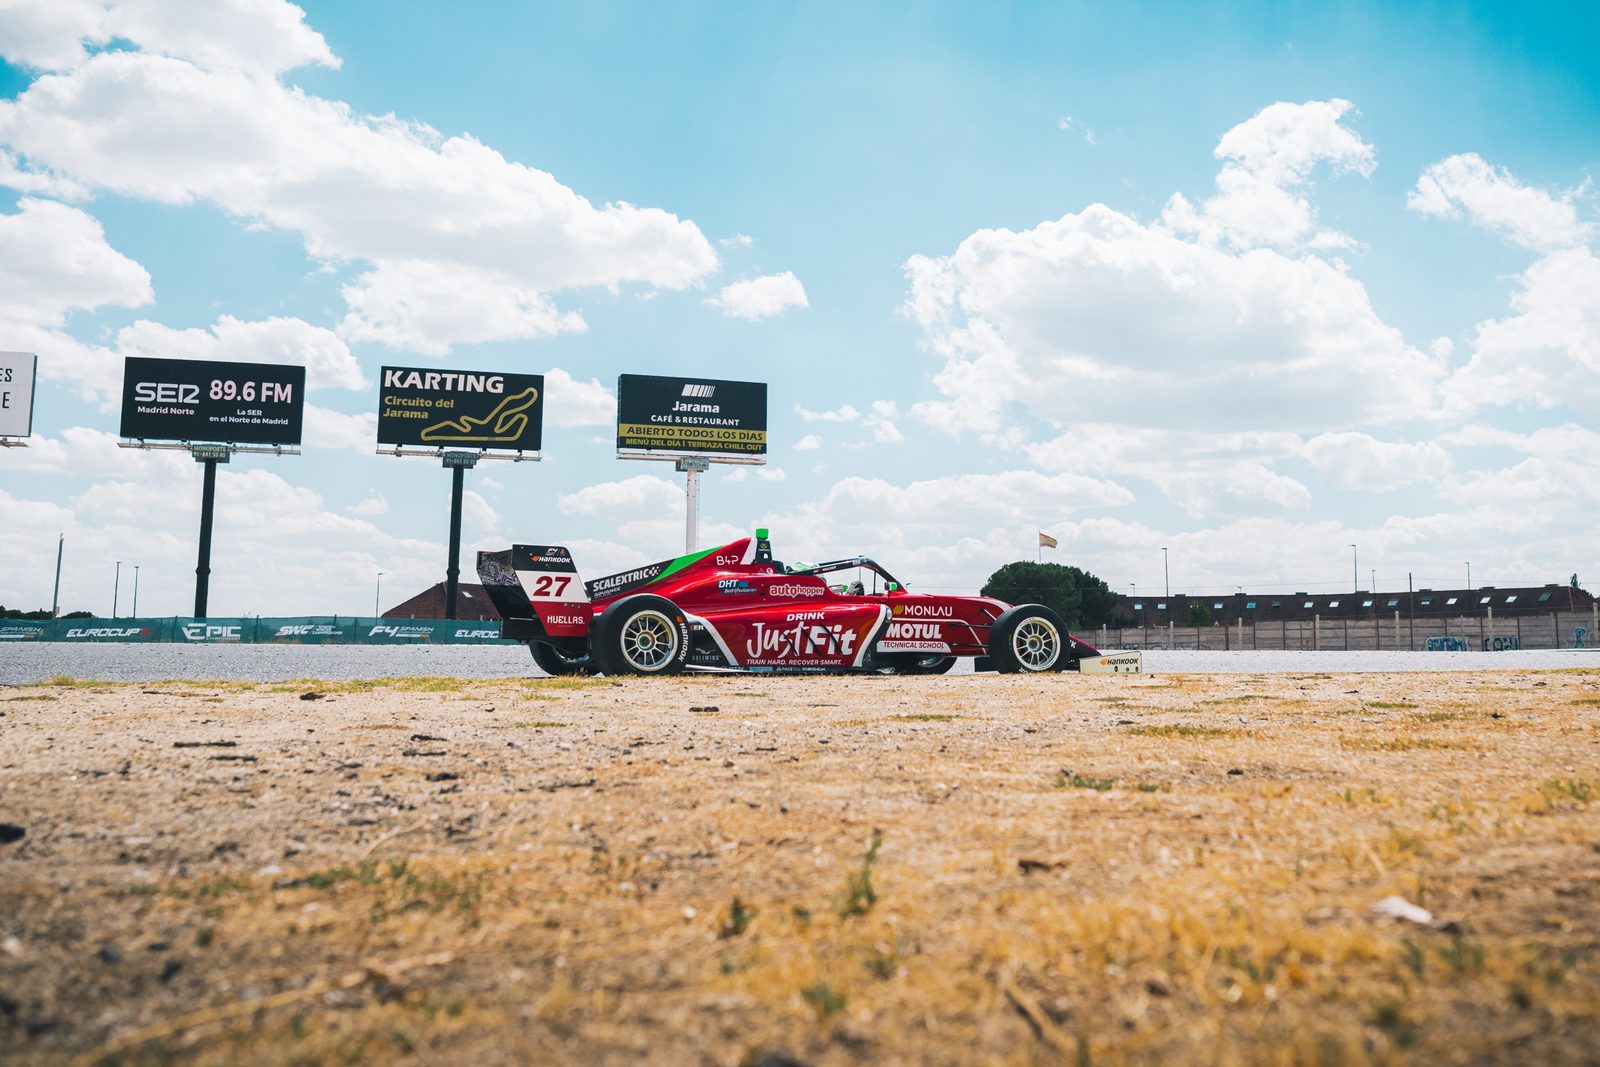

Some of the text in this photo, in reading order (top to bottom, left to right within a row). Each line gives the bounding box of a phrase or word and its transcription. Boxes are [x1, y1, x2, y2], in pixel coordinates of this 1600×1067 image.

[384, 370, 504, 393] KARTING
[134, 382, 200, 404] SER
[209, 380, 292, 403] 89.6 FM
[385, 396, 455, 408] Circuito del
[672, 401, 720, 413] Jarama
[137, 406, 195, 415] Madrid Norte
[383, 408, 429, 419] Jarama
[650, 414, 673, 423] CAFÉ
[682, 416, 740, 426] RESTAURANT
[627, 426, 763, 441] ABIERTO TODOS LOS DÍAS
[625, 438, 649, 446] MENÚ
[716, 555, 739, 565] B4P
[592, 568, 649, 592] SCALEXTRIC
[718, 580, 739, 588] DHT
[533, 576, 572, 597] 27
[770, 583, 825, 598] autohopper
[786, 612, 826, 621] DRINK
[904, 605, 953, 616] MONLAU
[547, 615, 585, 624] HUELLAS.
[181, 623, 241, 640] EPIC
[368, 626, 400, 637] F4
[455, 630, 499, 638] EUROC
[885, 623, 943, 639] MOTUL
